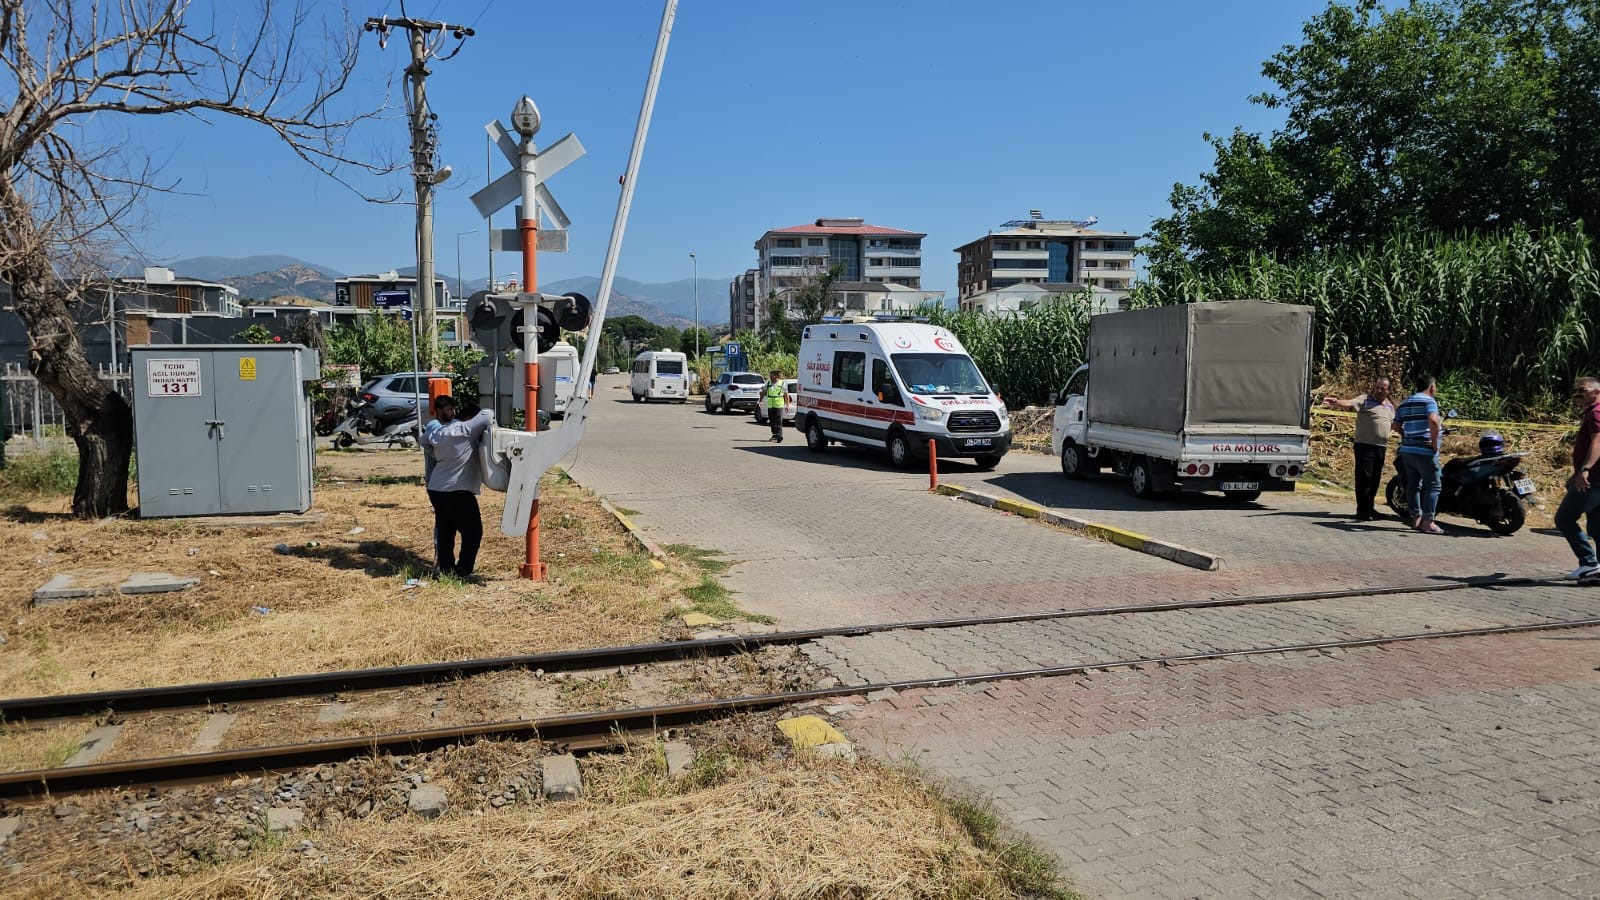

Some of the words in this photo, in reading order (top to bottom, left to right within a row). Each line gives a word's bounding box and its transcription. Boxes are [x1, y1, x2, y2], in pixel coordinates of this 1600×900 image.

[812, 372, 822, 386] 112
[162, 383, 188, 393] 131
[1212, 444, 1232, 452] KIA
[1235, 444, 1280, 453] MOTORS
